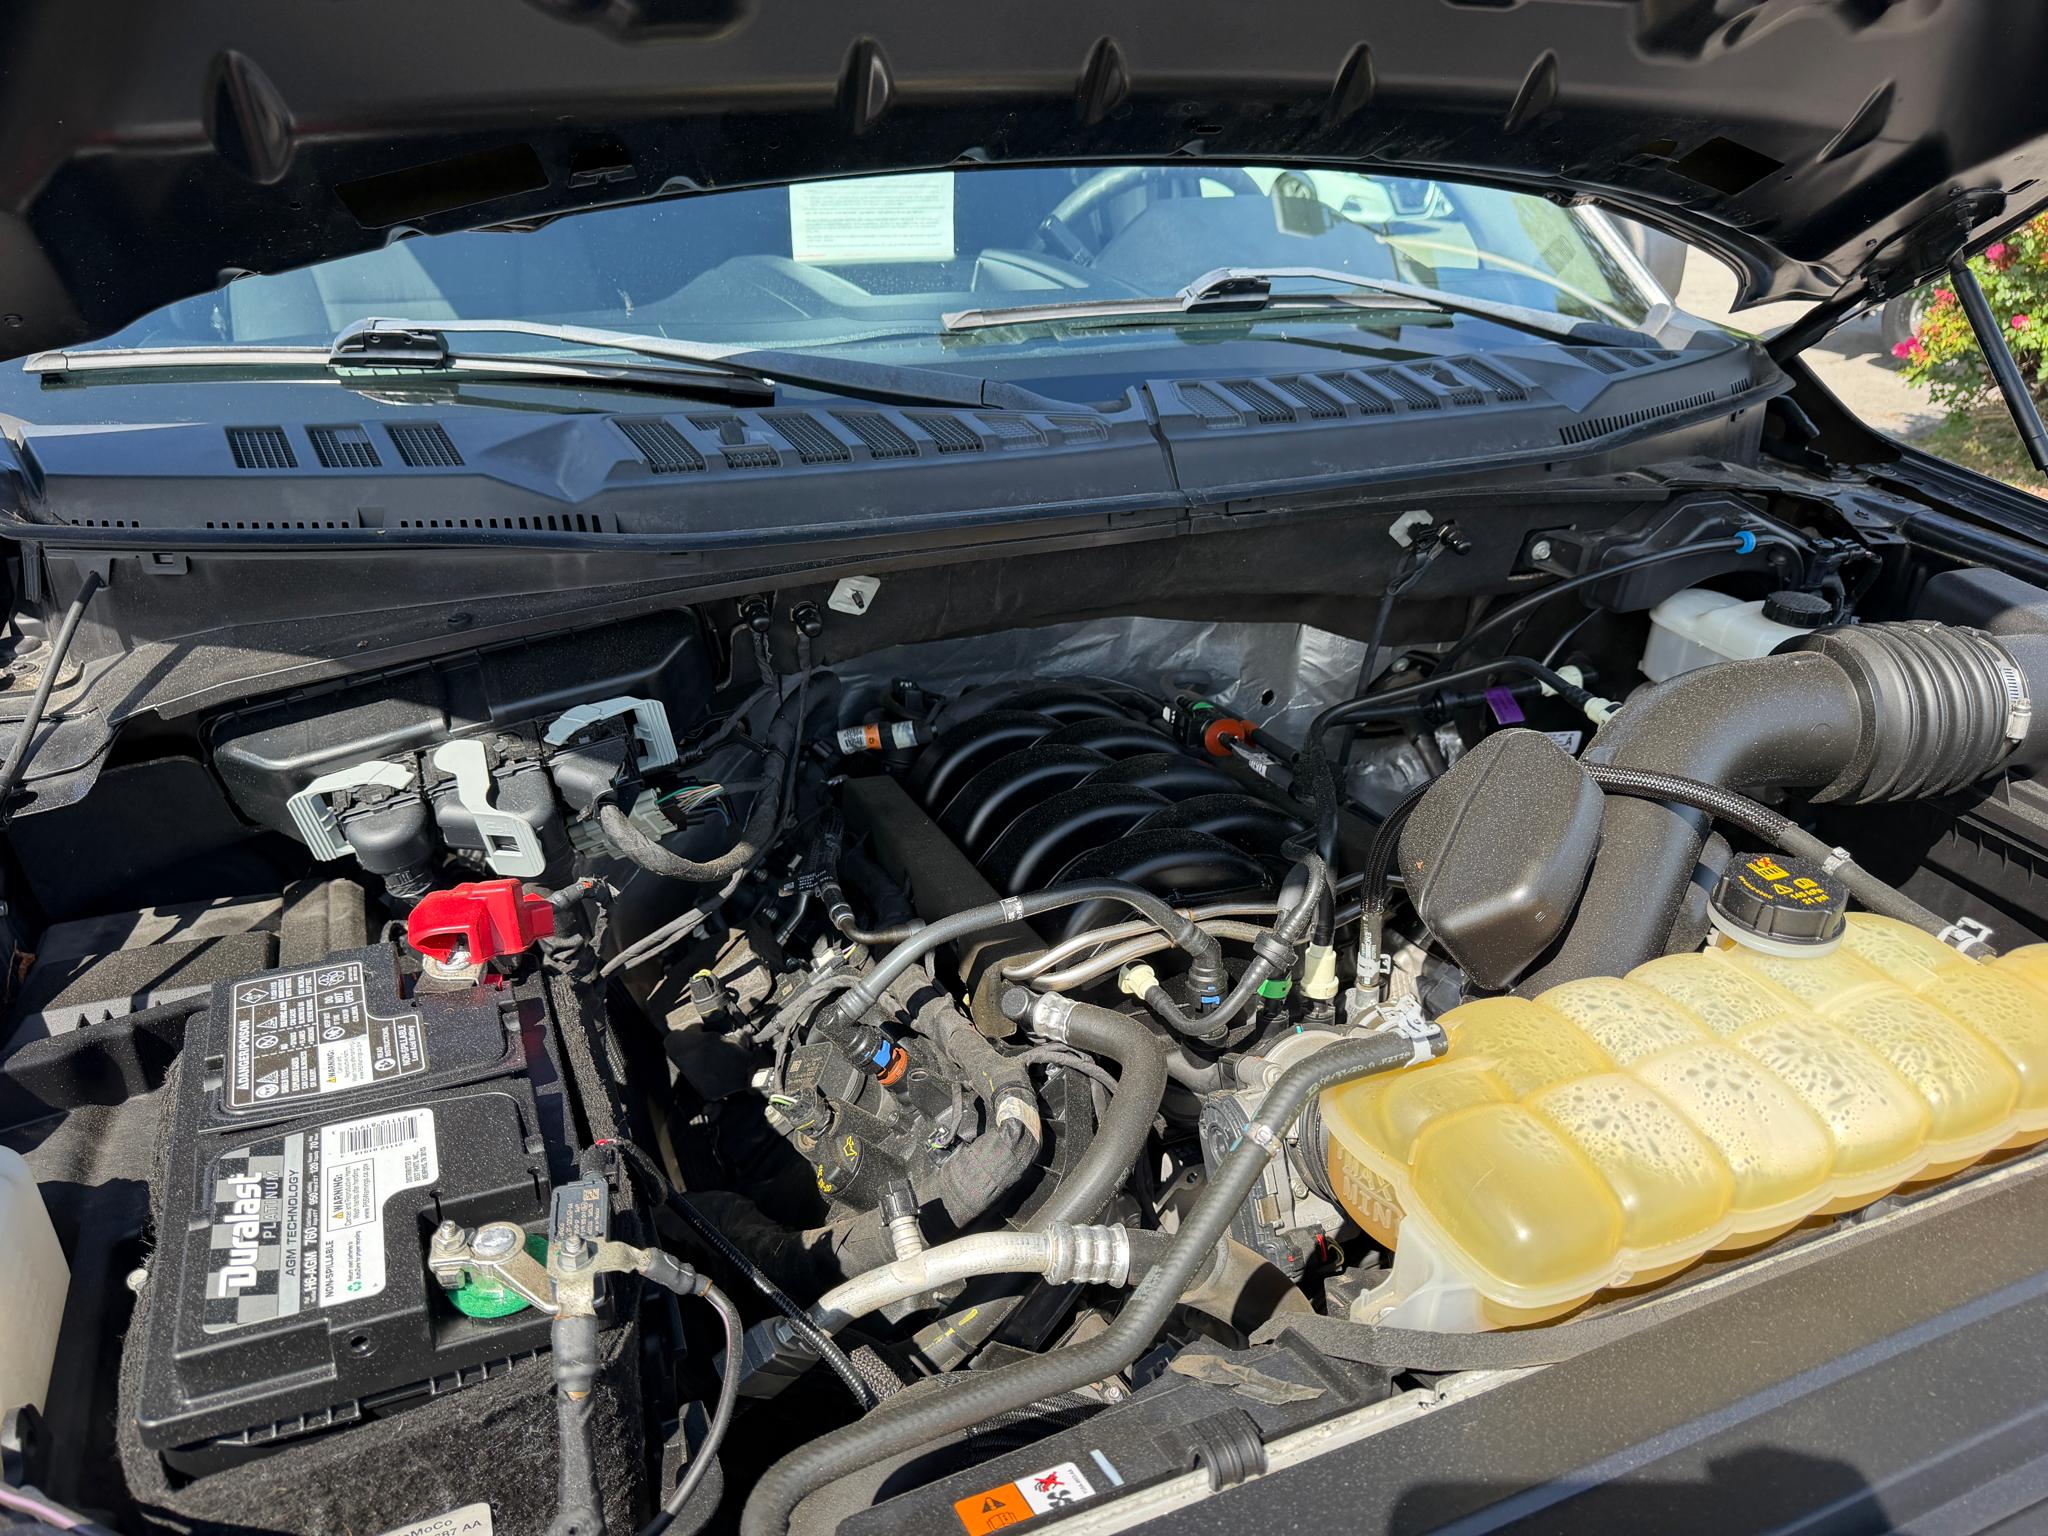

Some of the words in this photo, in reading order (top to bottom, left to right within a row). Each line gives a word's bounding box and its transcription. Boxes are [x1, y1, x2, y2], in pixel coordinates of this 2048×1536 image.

[237, 1018, 250, 1085] DANGER/POISON
[310, 1141, 318, 1150] 70
[309, 1161, 318, 1173] 120
[262, 1168, 279, 1239] PLATINUM
[286, 1169, 298, 1245] TECHNOLOGY
[309, 1191, 318, 1205] 950
[333, 1173, 342, 1212] WARNING:
[1343, 1175, 1392, 1230] MIN
[218, 1172, 262, 1298] Duralast
[304, 1226, 317, 1245] 760
[285, 1247, 296, 1277] AGM
[303, 1250, 317, 1291] H6-AGM
[324, 1238, 334, 1299] NON-SPILLABLE
[462, 1519, 482, 1532] AA
